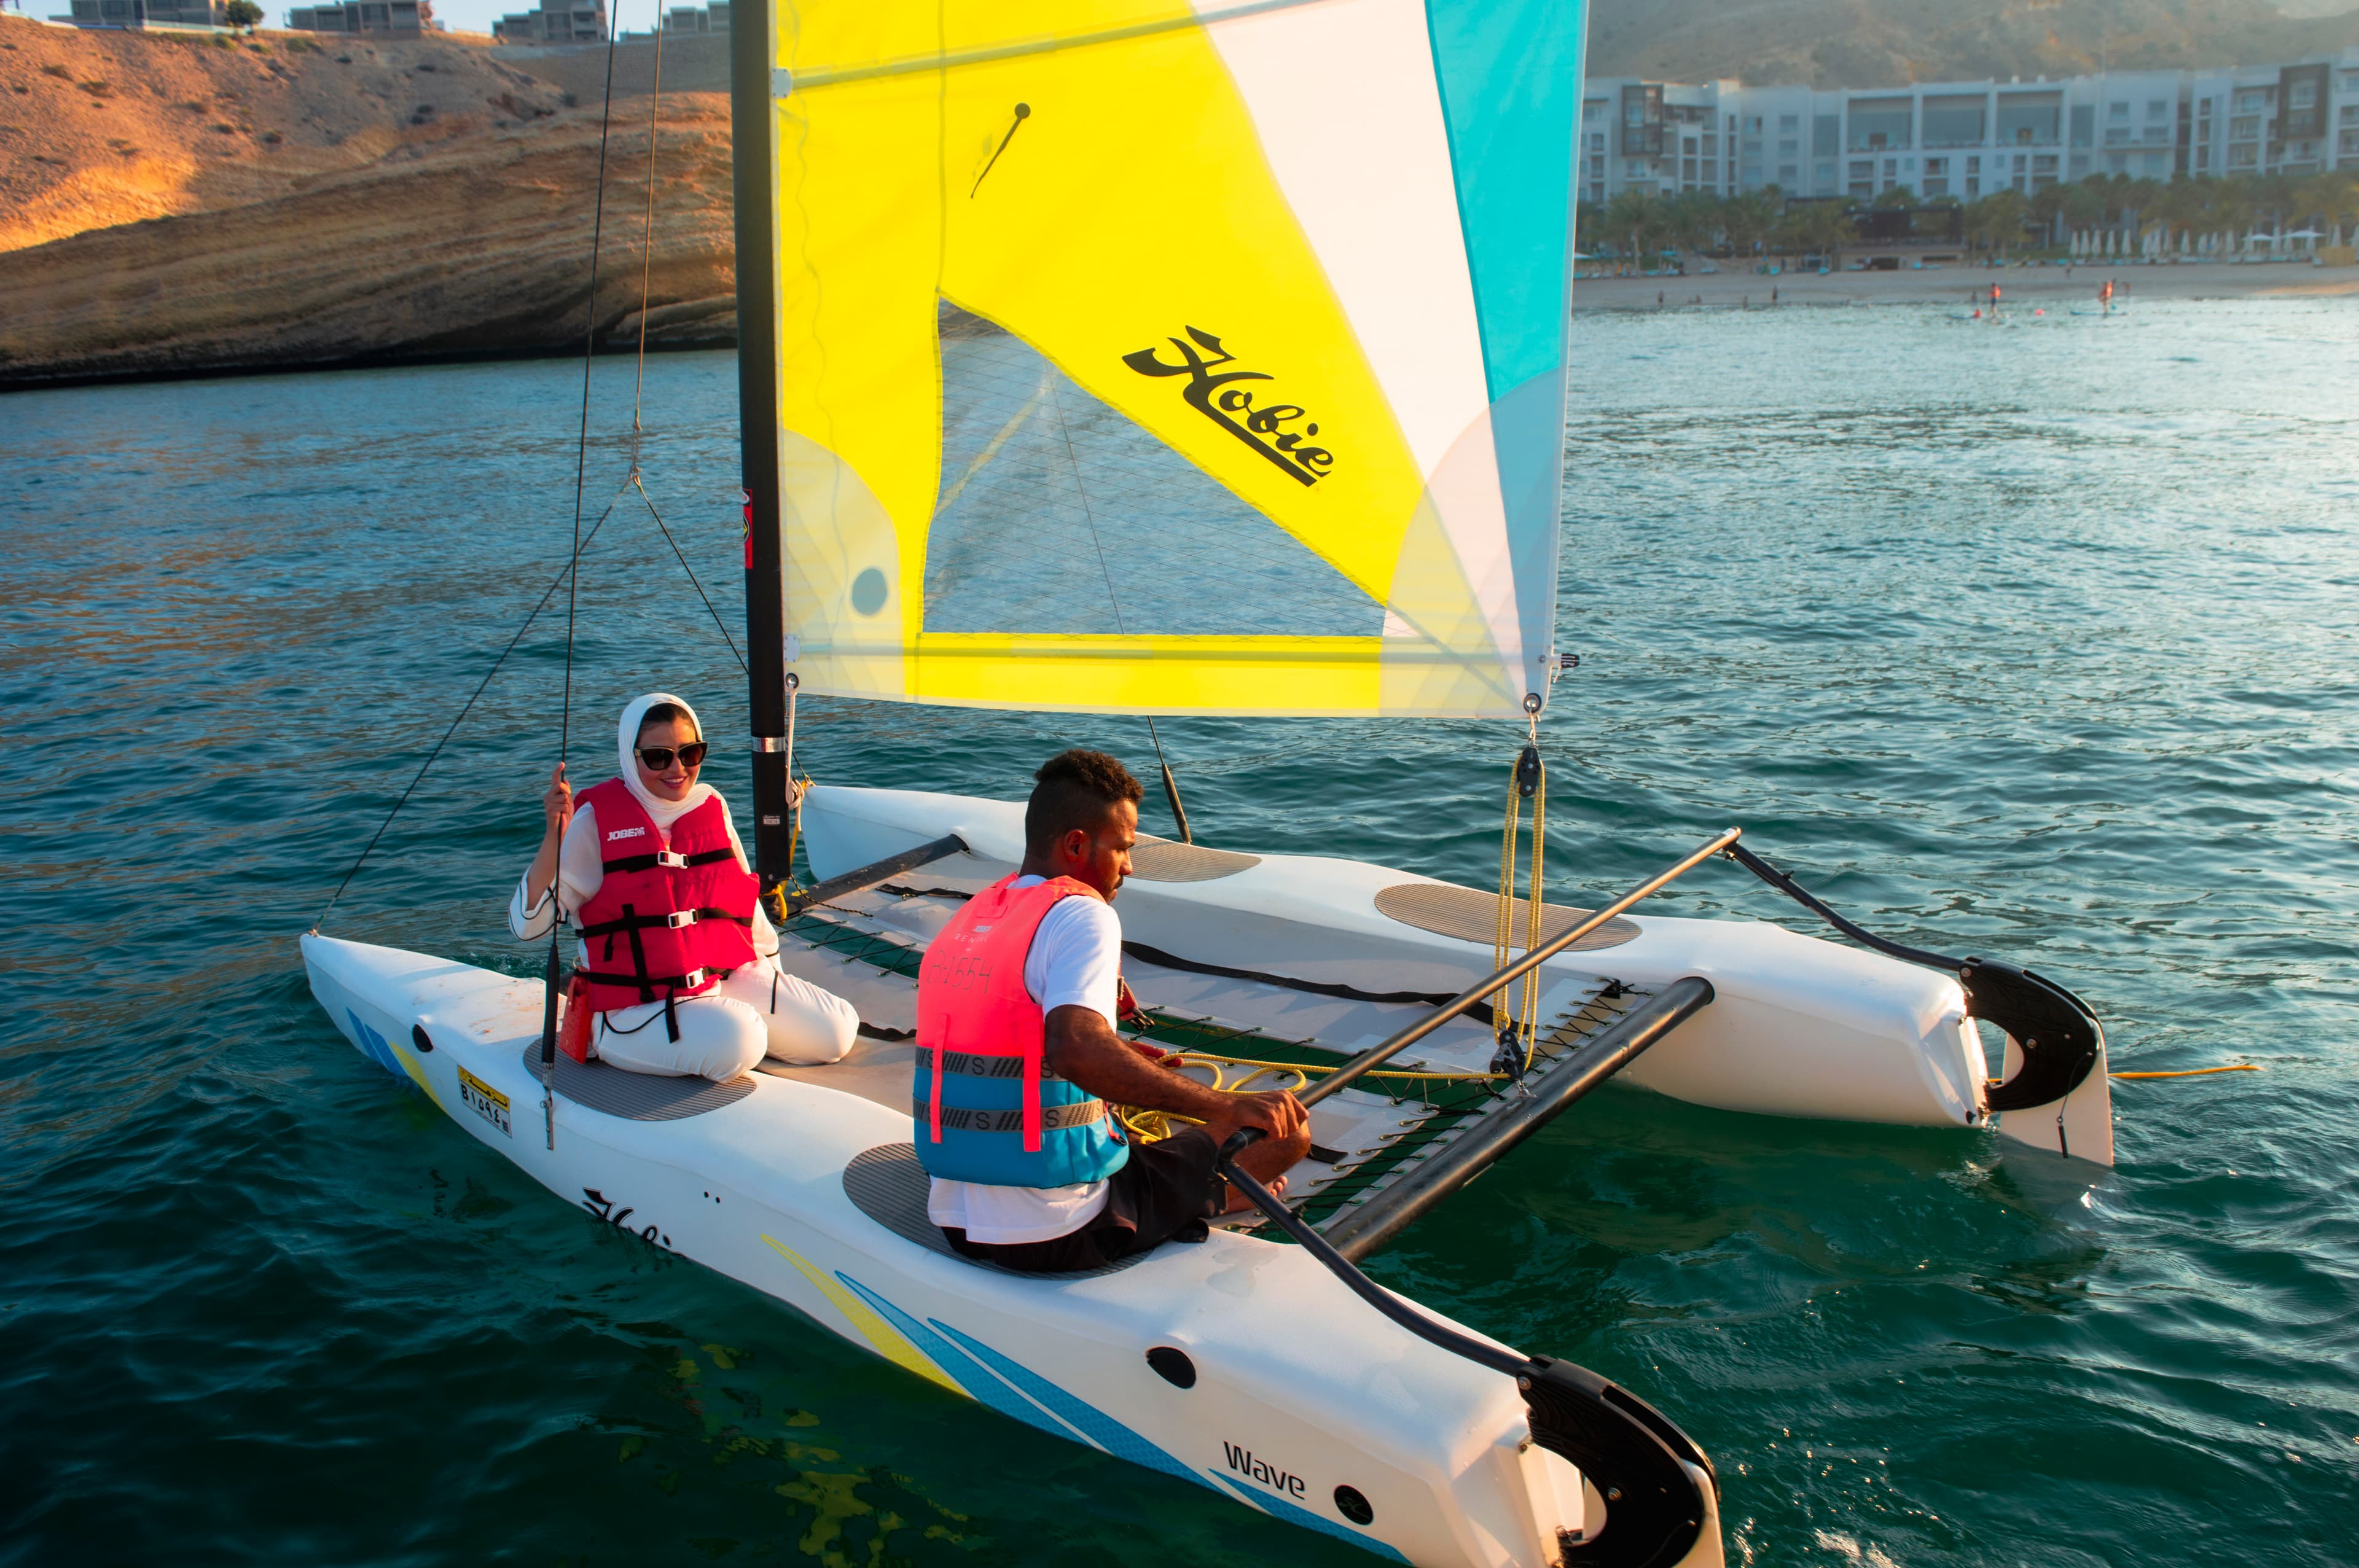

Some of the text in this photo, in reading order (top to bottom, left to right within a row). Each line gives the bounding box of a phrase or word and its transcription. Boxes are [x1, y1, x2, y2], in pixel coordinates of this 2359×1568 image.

[1122, 324, 1334, 487] Hobie
[607, 828, 635, 841] JOBE
[1223, 1440, 1305, 1500] Wave
